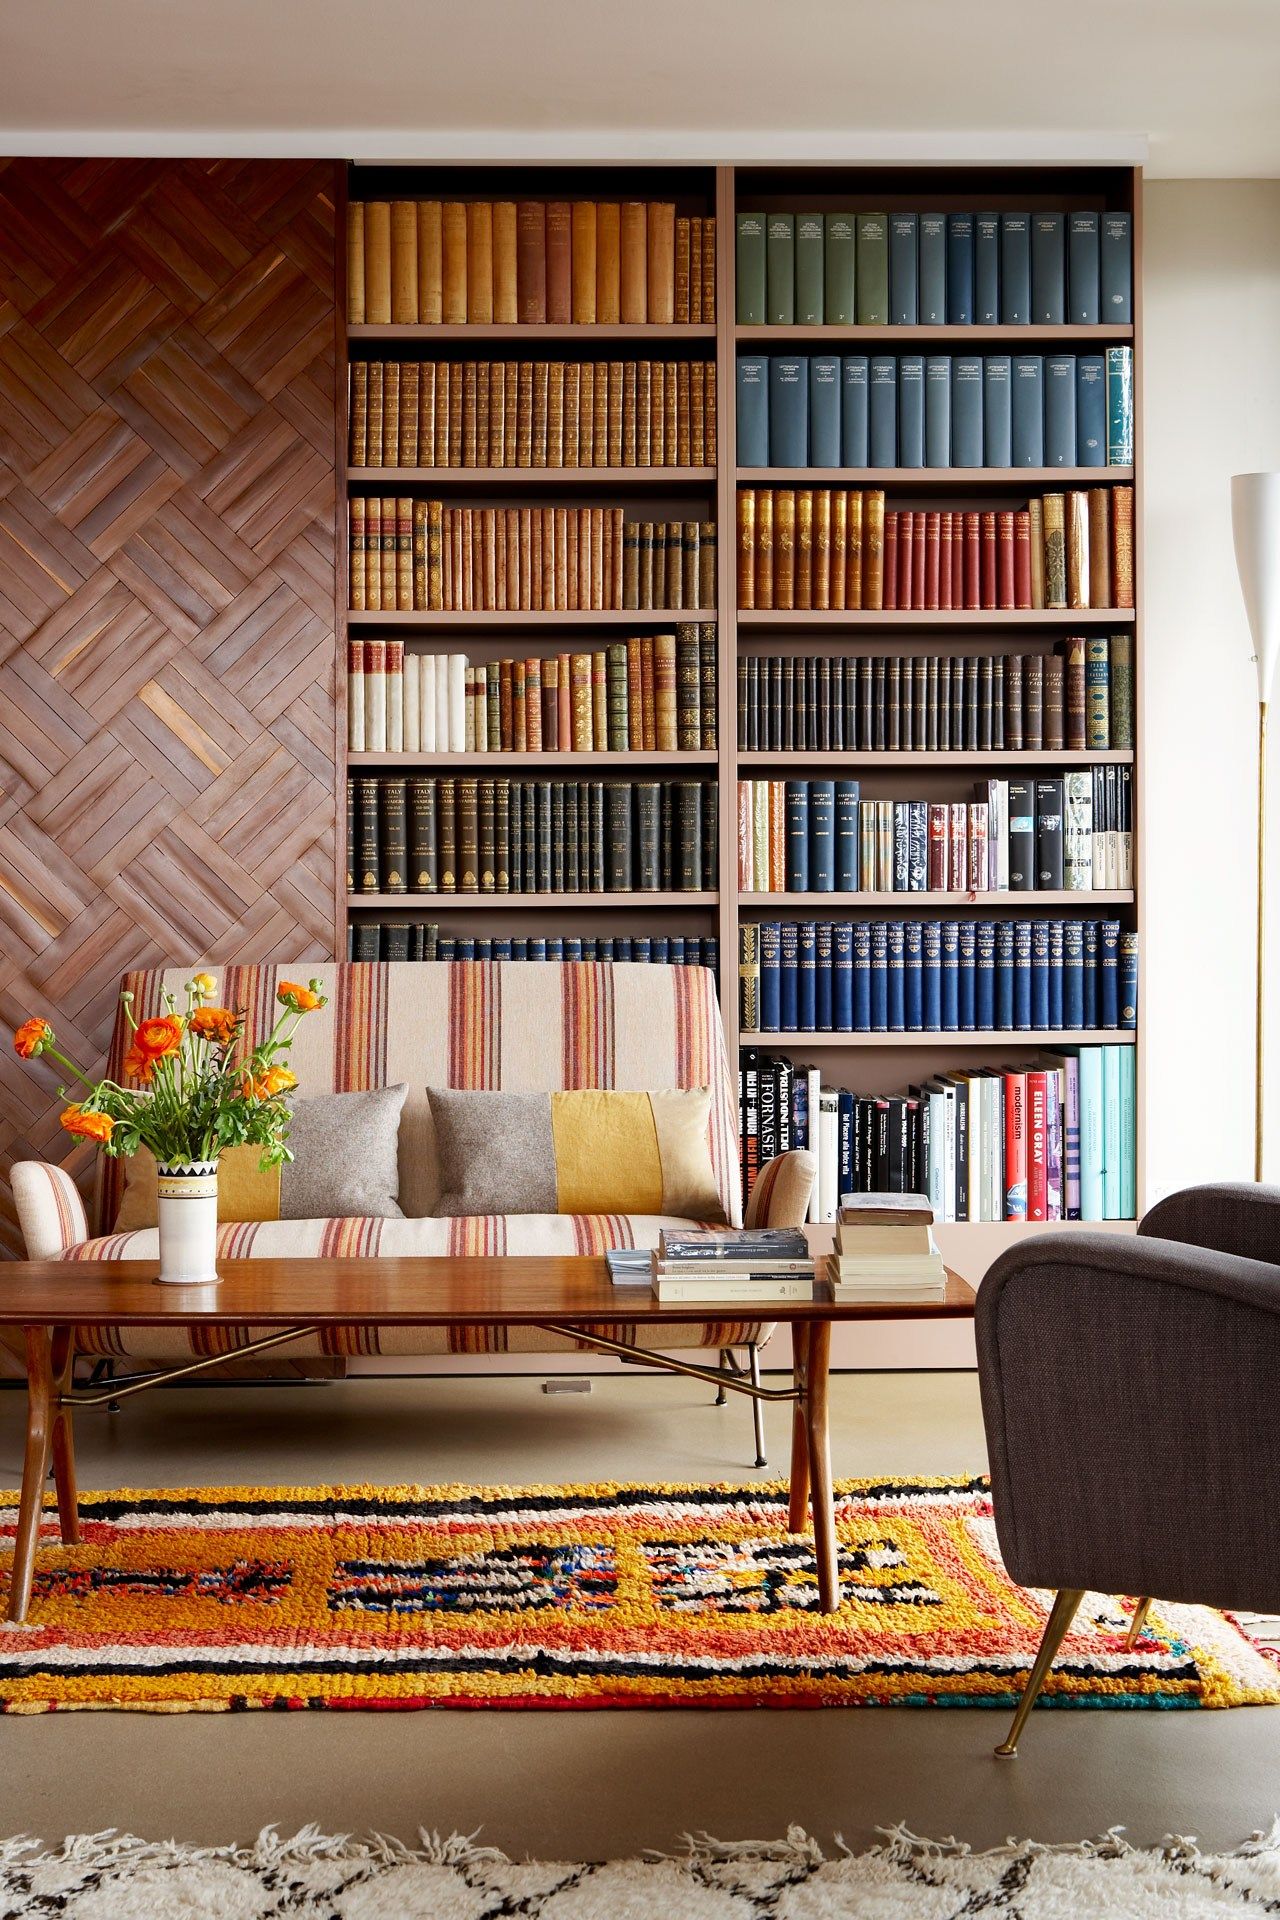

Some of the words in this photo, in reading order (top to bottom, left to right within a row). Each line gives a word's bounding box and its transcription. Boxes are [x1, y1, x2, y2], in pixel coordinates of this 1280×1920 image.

[780, 1066, 790, 1150] DELL'INDUSTRIA
[1014, 1086, 1022, 1140] modernism
[1034, 1091, 1043, 1128] EILEEN
[1034, 1132, 1043, 1164] GRAY
